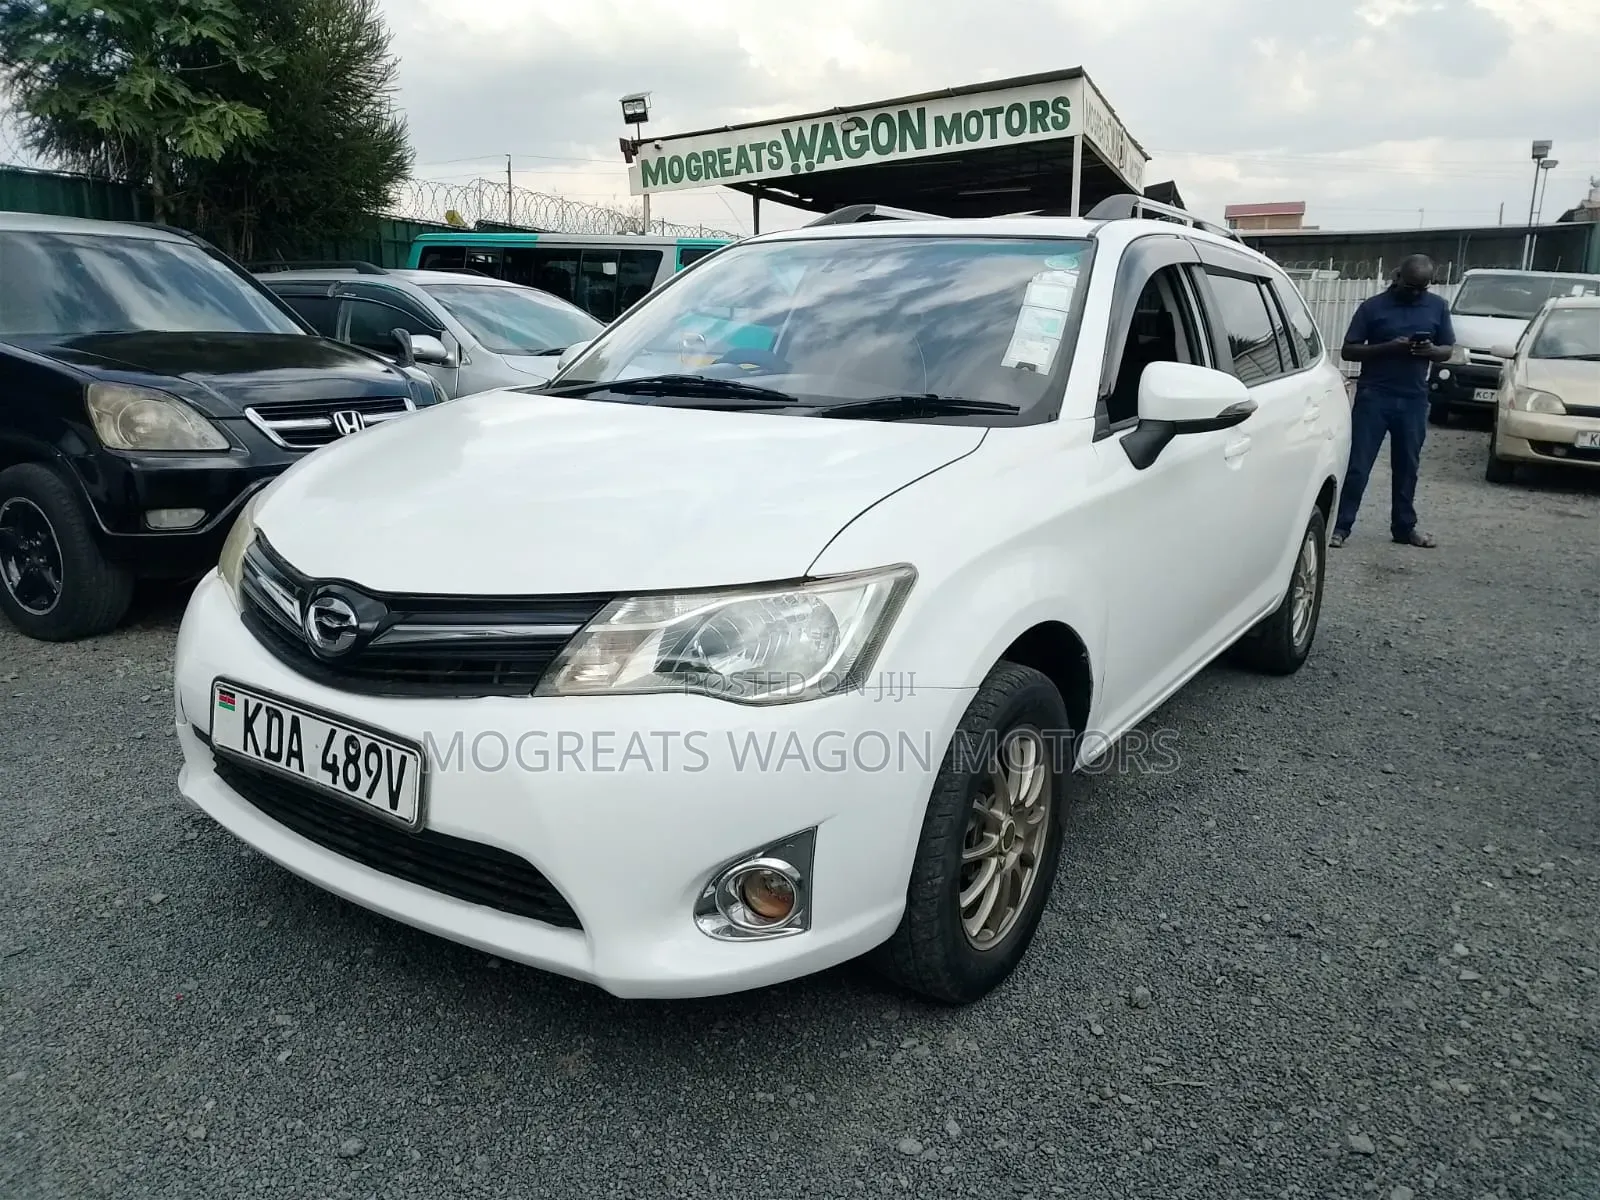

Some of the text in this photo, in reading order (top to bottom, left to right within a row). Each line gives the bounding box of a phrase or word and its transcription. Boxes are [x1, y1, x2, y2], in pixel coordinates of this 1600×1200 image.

[641, 139, 784, 189] MOGREATS
[781, 107, 927, 174] WAGON
[934, 96, 1071, 148] MOTORS
[1590, 433, 1600, 446] K
[243, 698, 408, 811] KDA 489V
